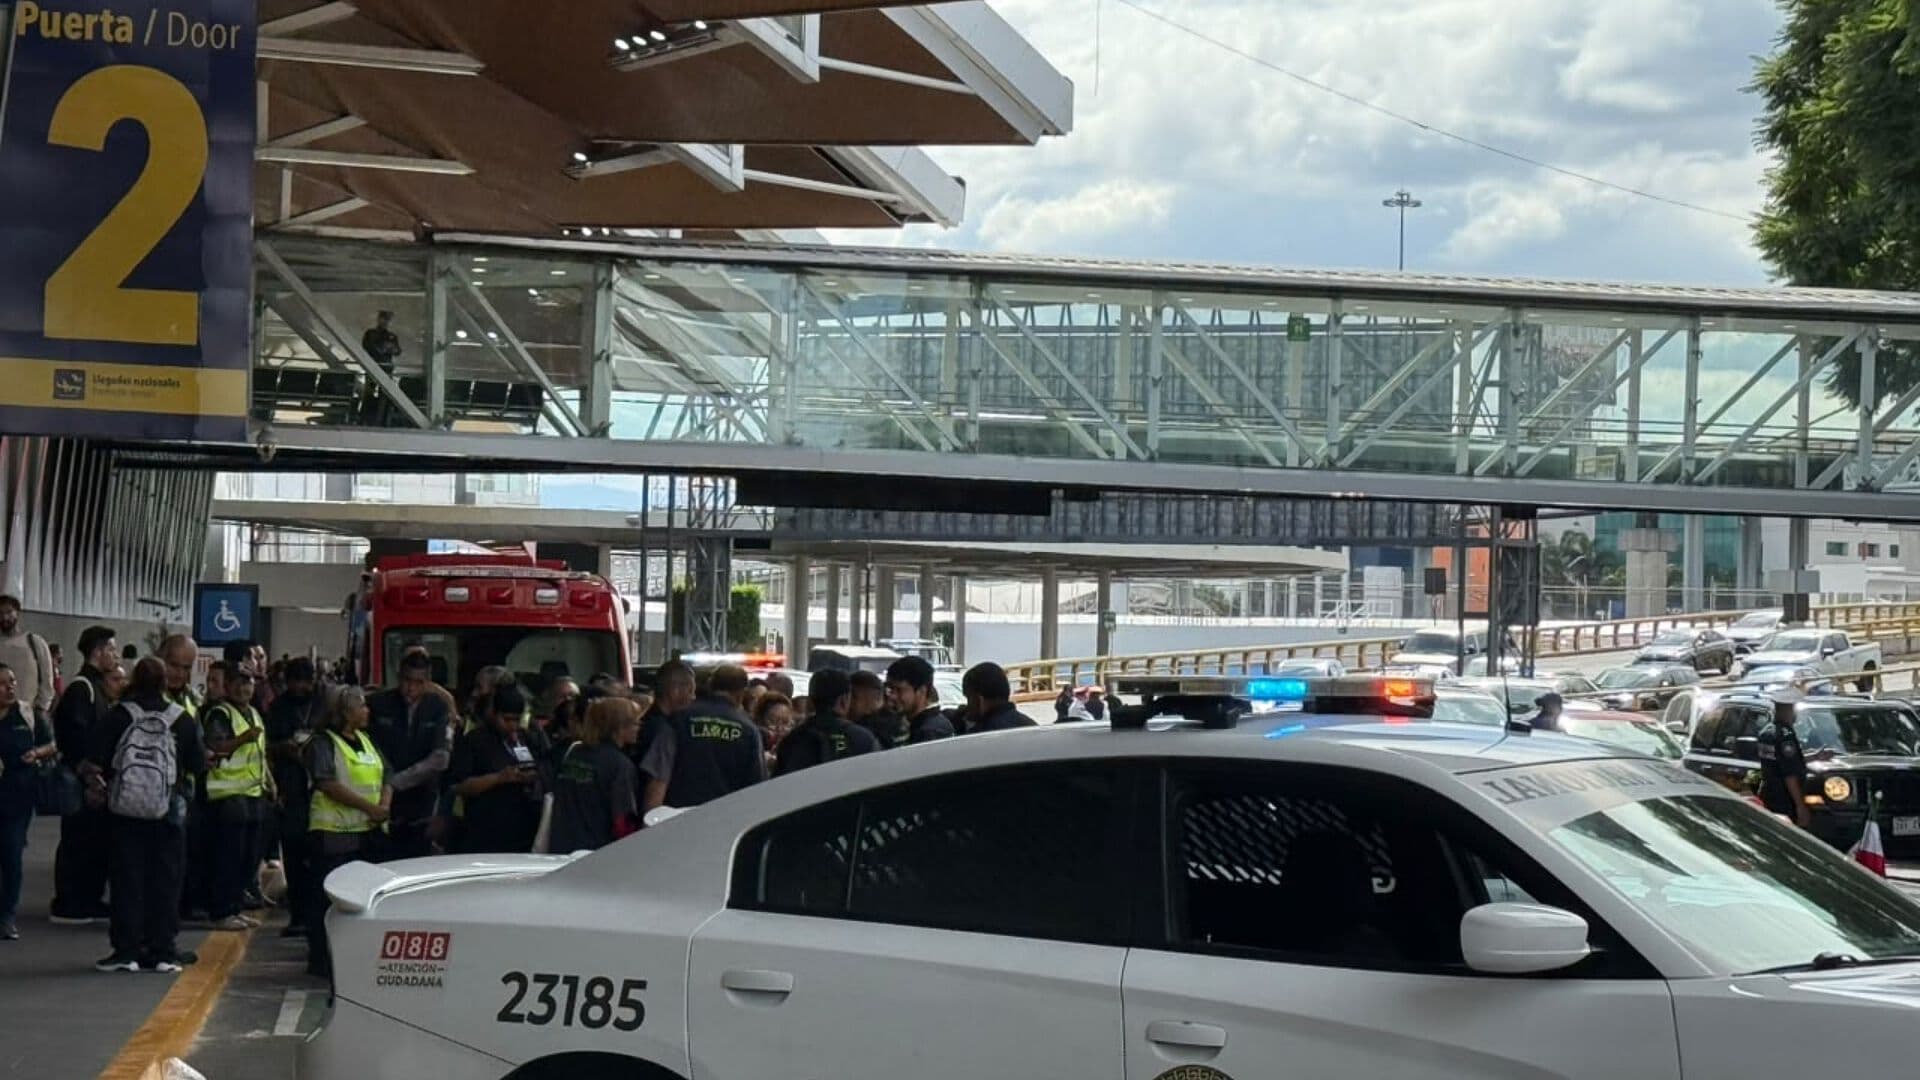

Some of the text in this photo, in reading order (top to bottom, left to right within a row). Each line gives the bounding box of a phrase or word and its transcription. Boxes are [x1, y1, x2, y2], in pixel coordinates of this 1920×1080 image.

[15, 0, 241, 49] Puerta / Door
[44, 64, 209, 346] 2
[133, 376, 181, 388] nacionales
[385, 935, 445, 957] 088
[376, 975, 442, 987] CIUDADANA
[497, 970, 648, 1032] 23185
